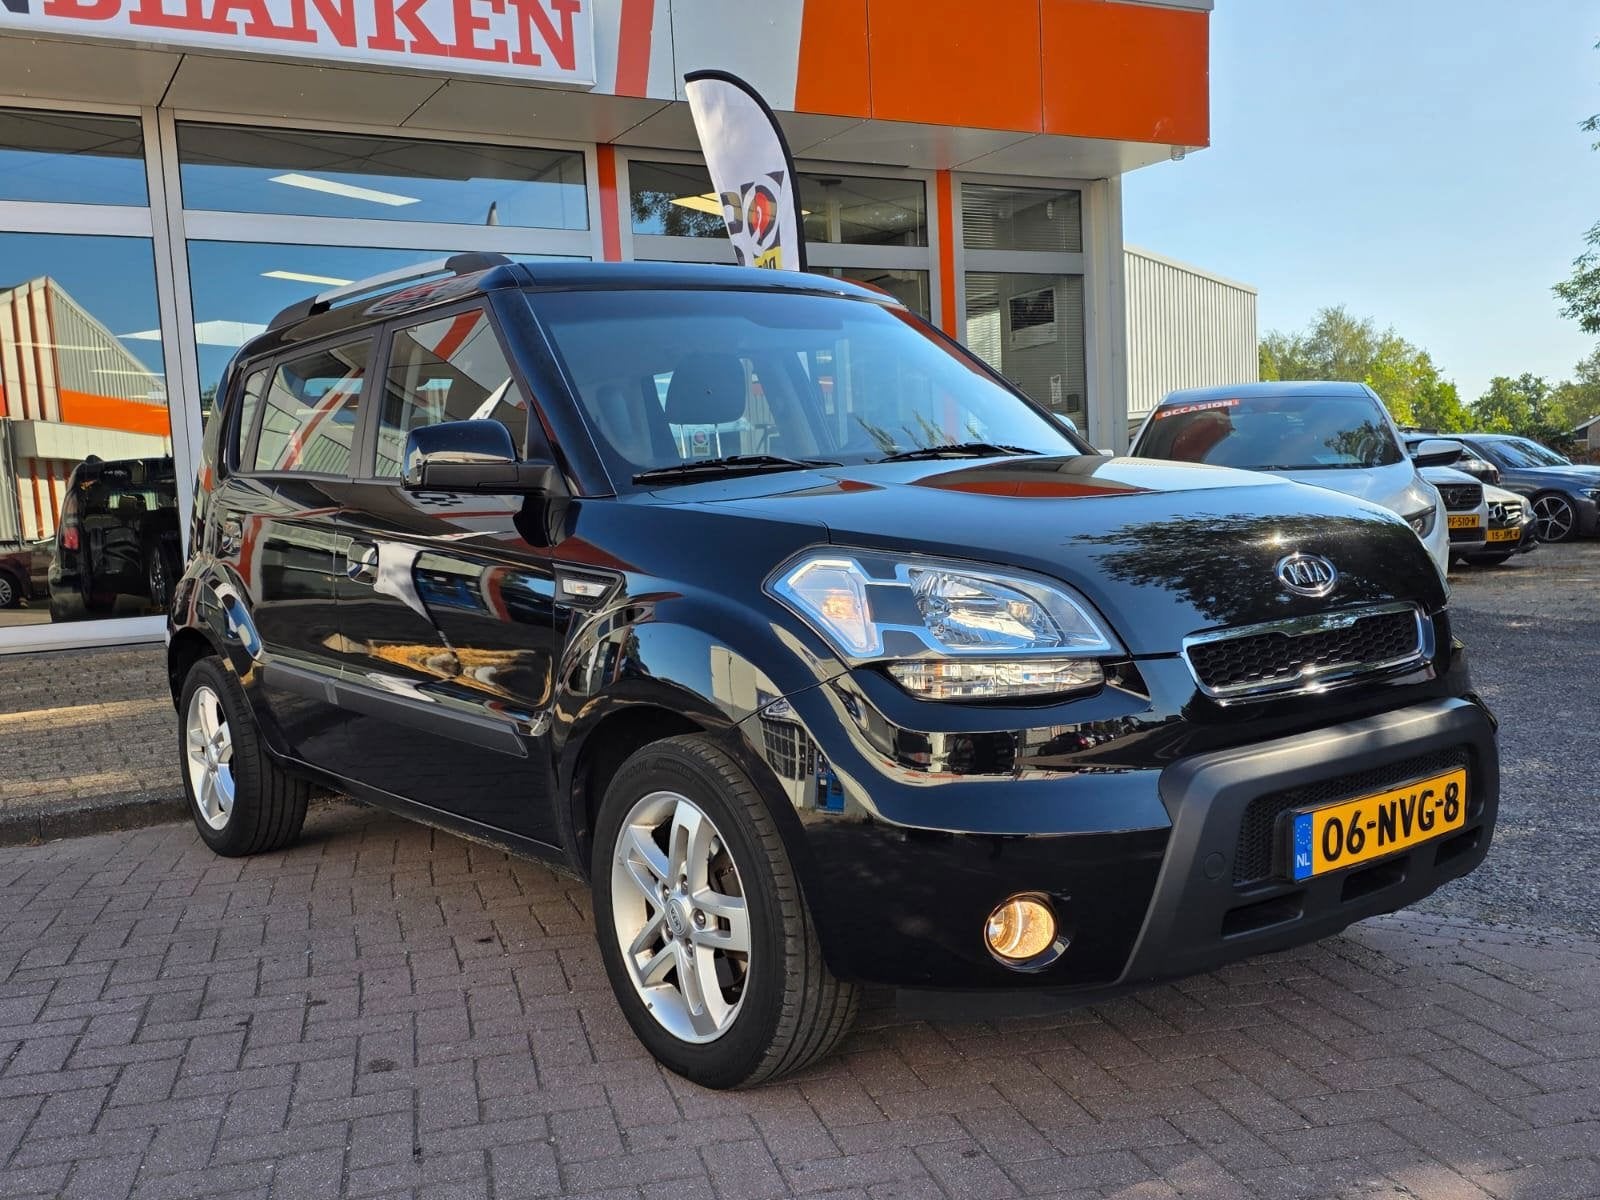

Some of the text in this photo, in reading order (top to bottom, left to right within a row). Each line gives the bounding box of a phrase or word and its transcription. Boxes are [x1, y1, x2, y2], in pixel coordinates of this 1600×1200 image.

[1284, 560, 1329, 585] KIA
[1321, 782, 1460, 863] 06-NVG-8
[1296, 853, 1311, 869] NL
